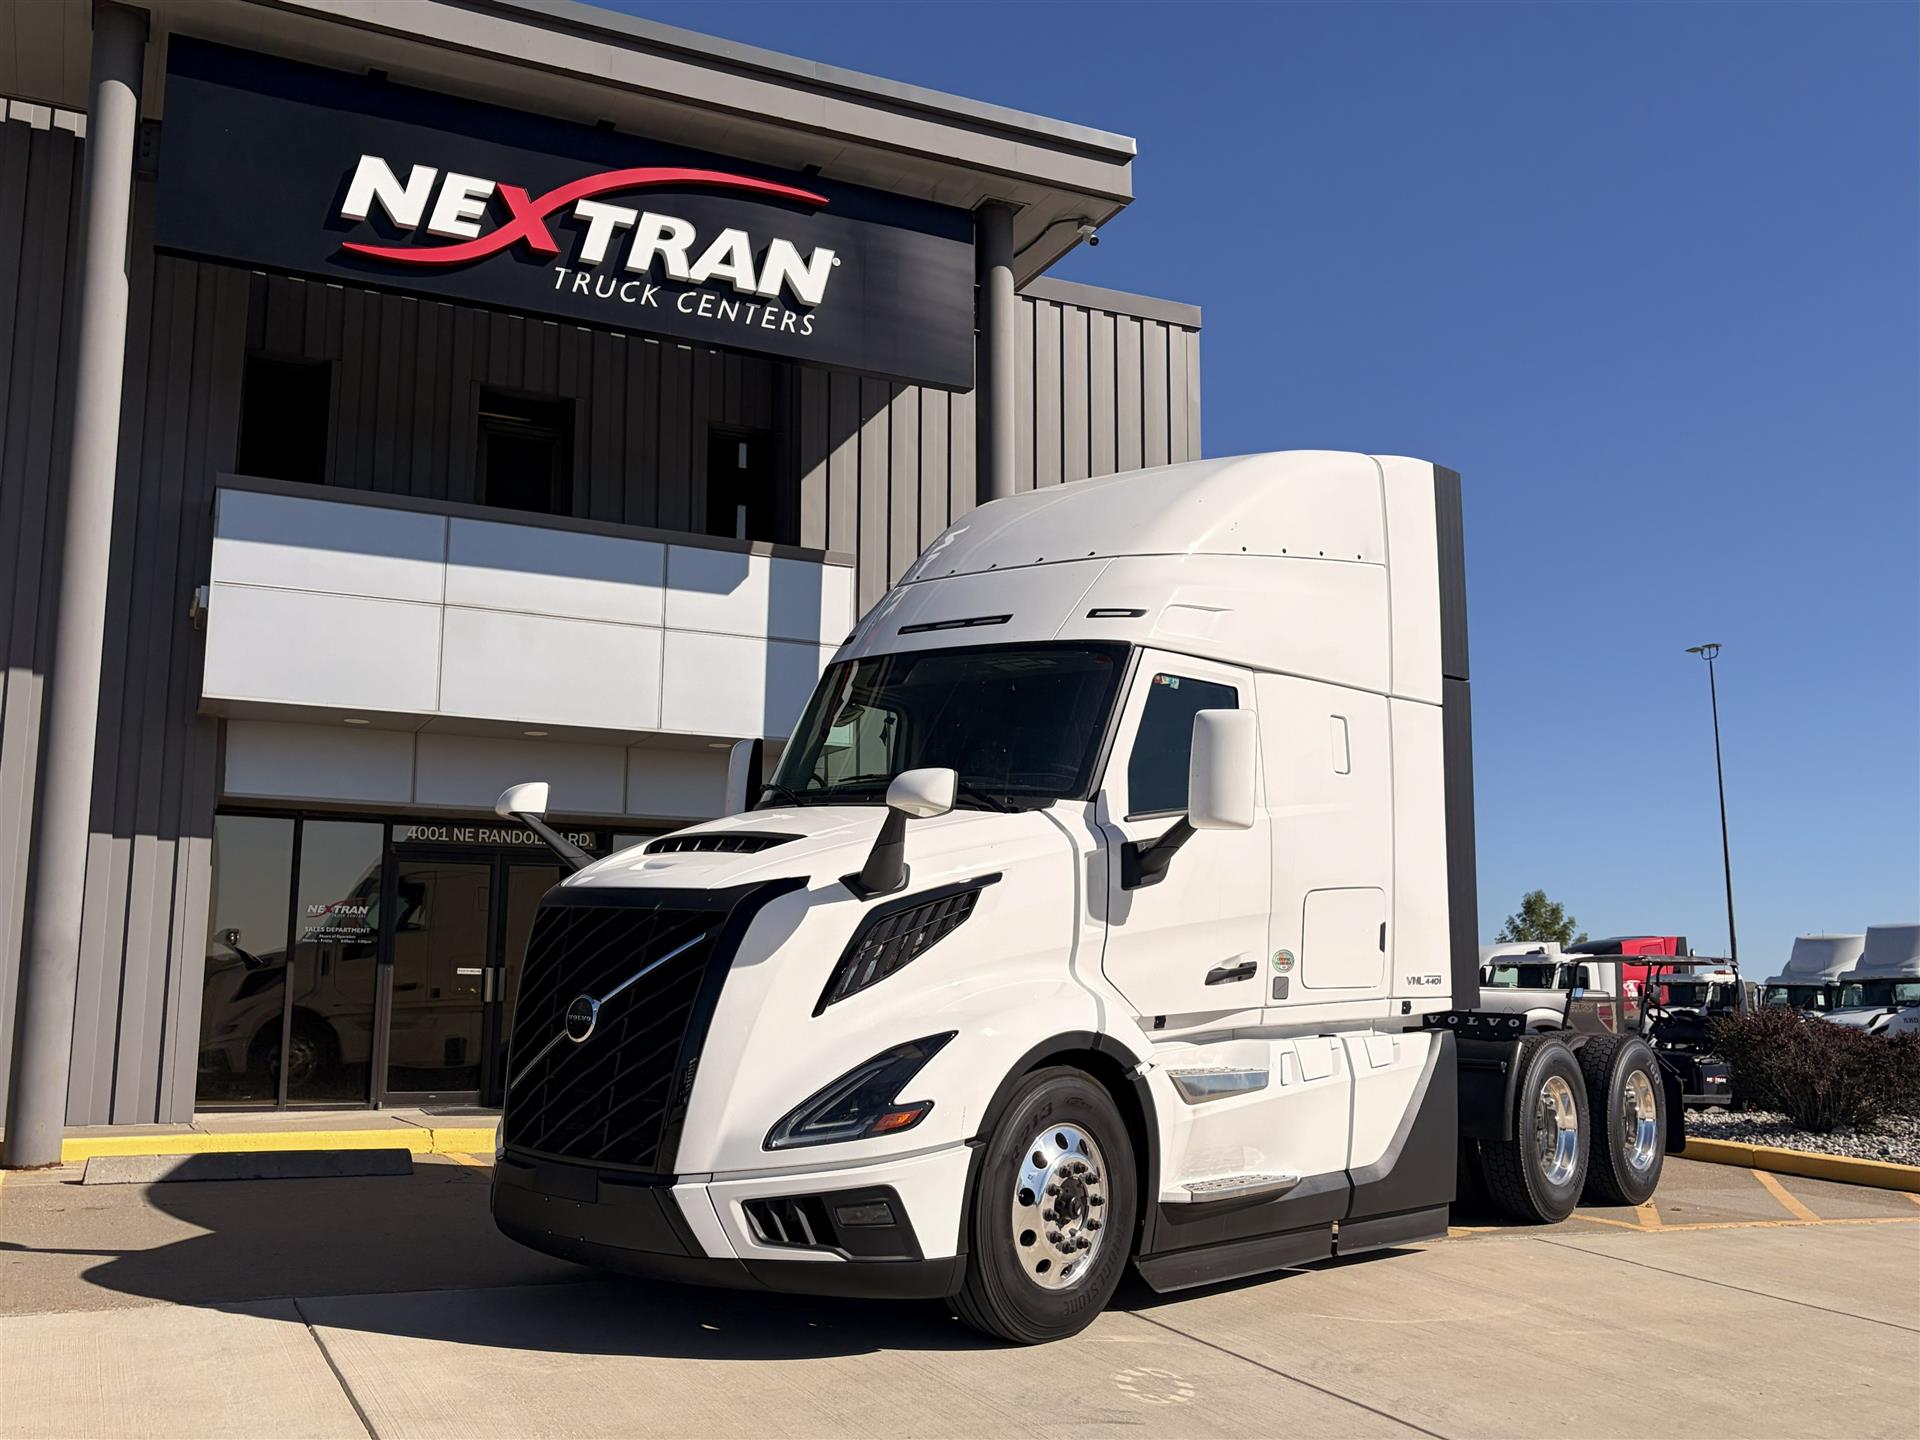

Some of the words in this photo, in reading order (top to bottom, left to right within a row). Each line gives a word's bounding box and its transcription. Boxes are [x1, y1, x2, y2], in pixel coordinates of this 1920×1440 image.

[341, 154, 836, 305] NEXTRAN
[554, 267, 659, 308] TRUCK
[677, 292, 815, 336] CENTERS
[407, 825, 449, 841] 4001
[453, 827, 475, 842] NE
[478, 828, 568, 846] RANDOL
[568, 832, 593, 847] RD.
[307, 904, 369, 914] NEXTRAN
[326, 926, 371, 934] DEPARTMENT
[1406, 976, 1424, 986] VNL
[1427, 1015, 1520, 1028] VOLVO
